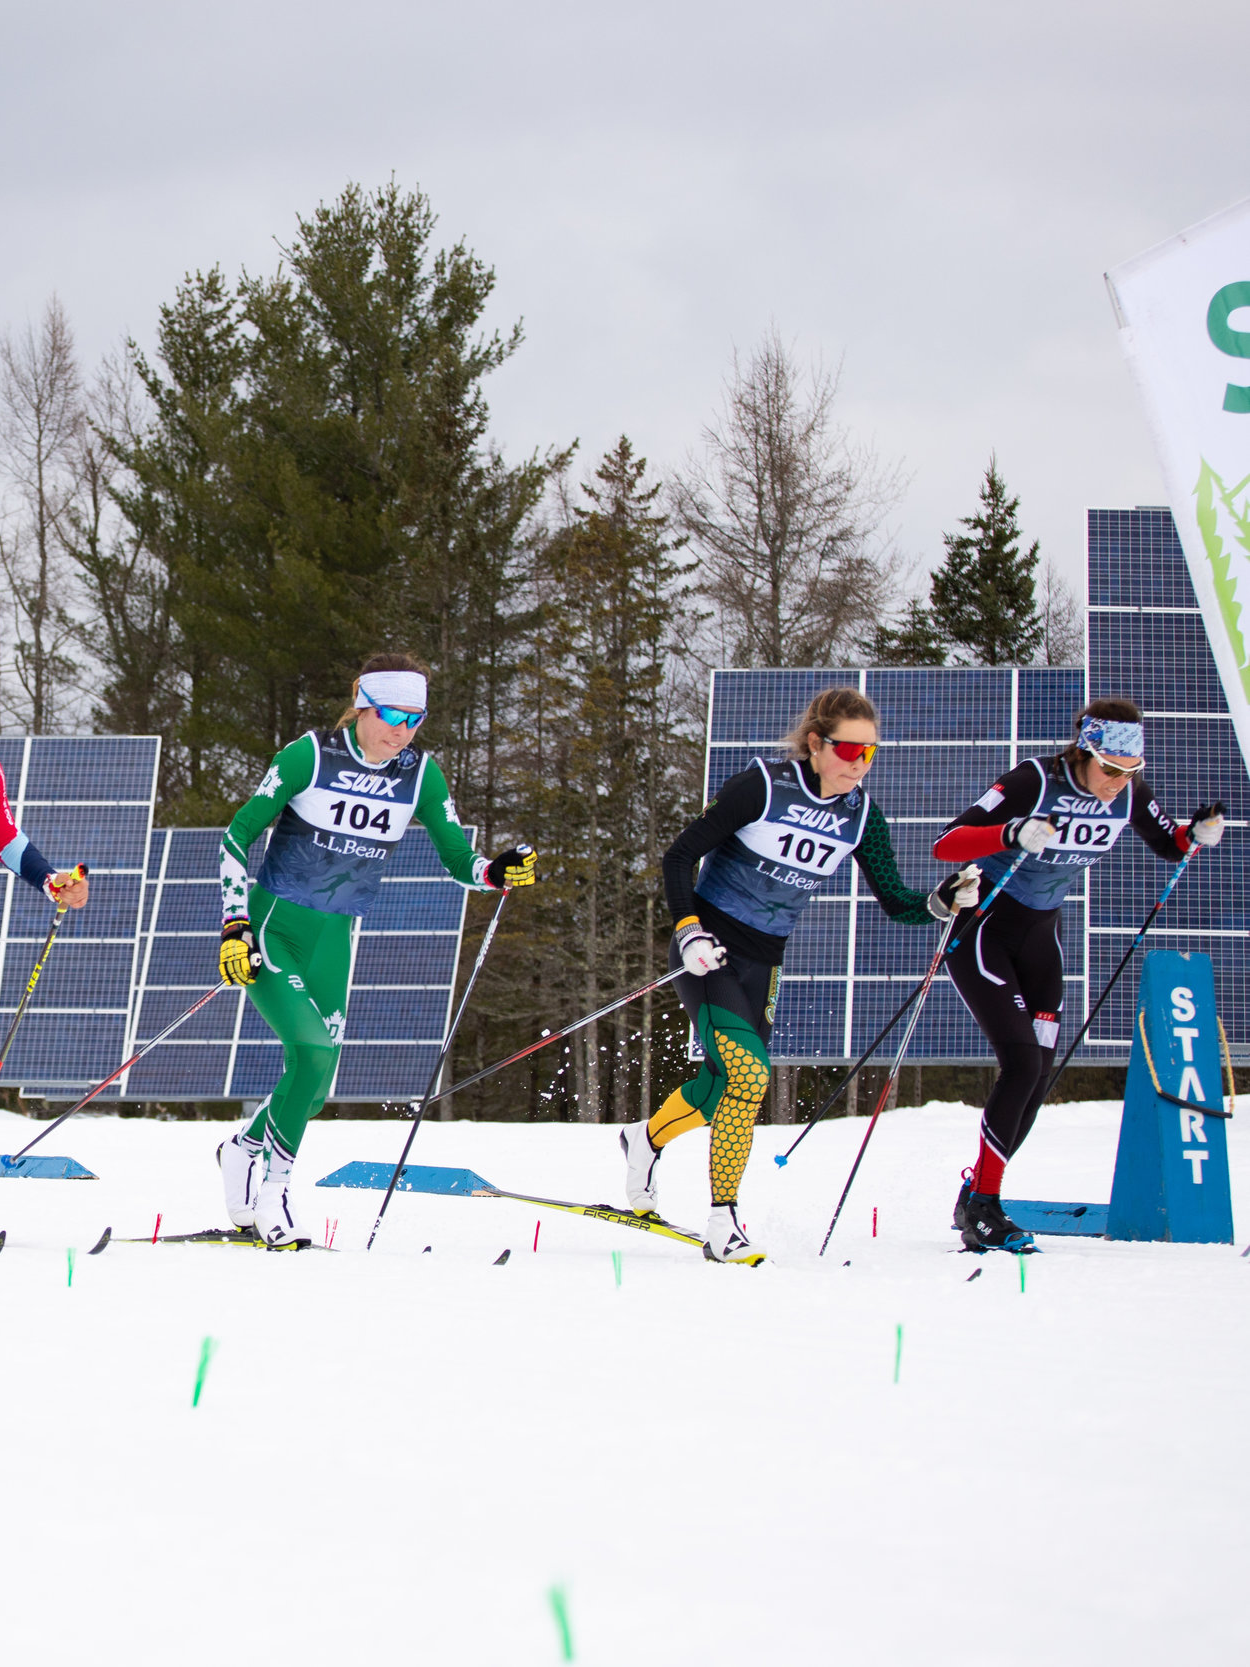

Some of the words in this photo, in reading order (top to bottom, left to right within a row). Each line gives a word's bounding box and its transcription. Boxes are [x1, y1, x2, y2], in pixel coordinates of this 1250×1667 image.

[330, 770, 402, 798] SWIX
[329, 800, 391, 834] 104
[778, 804, 849, 836] SWIX
[1051, 795, 1117, 816] SWIX
[312, 831, 388, 860] L.L.Bean
[1057, 823, 1111, 846] 102
[777, 833, 837, 869] 107
[1170, 986, 1210, 1185] START
[583, 1209, 651, 1231] FISCHER
